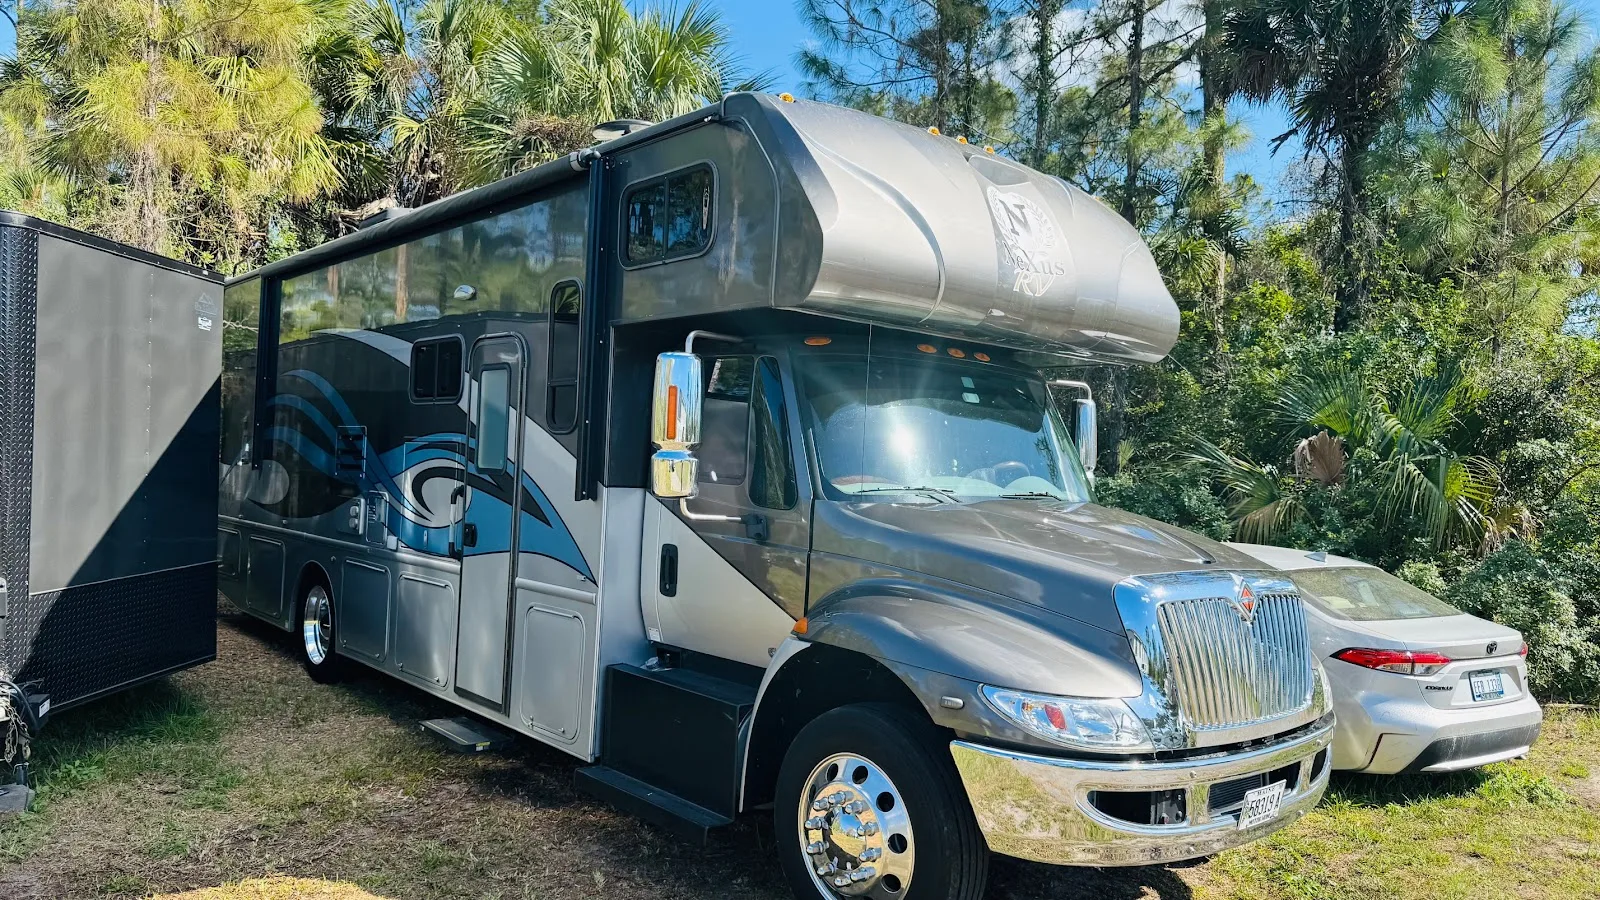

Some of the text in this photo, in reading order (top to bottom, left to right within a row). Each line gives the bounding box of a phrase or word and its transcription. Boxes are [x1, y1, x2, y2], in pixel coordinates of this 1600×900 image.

[1013, 268, 1056, 296] RV
[1248, 791, 1281, 818] 58319 A
[1257, 787, 1275, 796] MAINE
